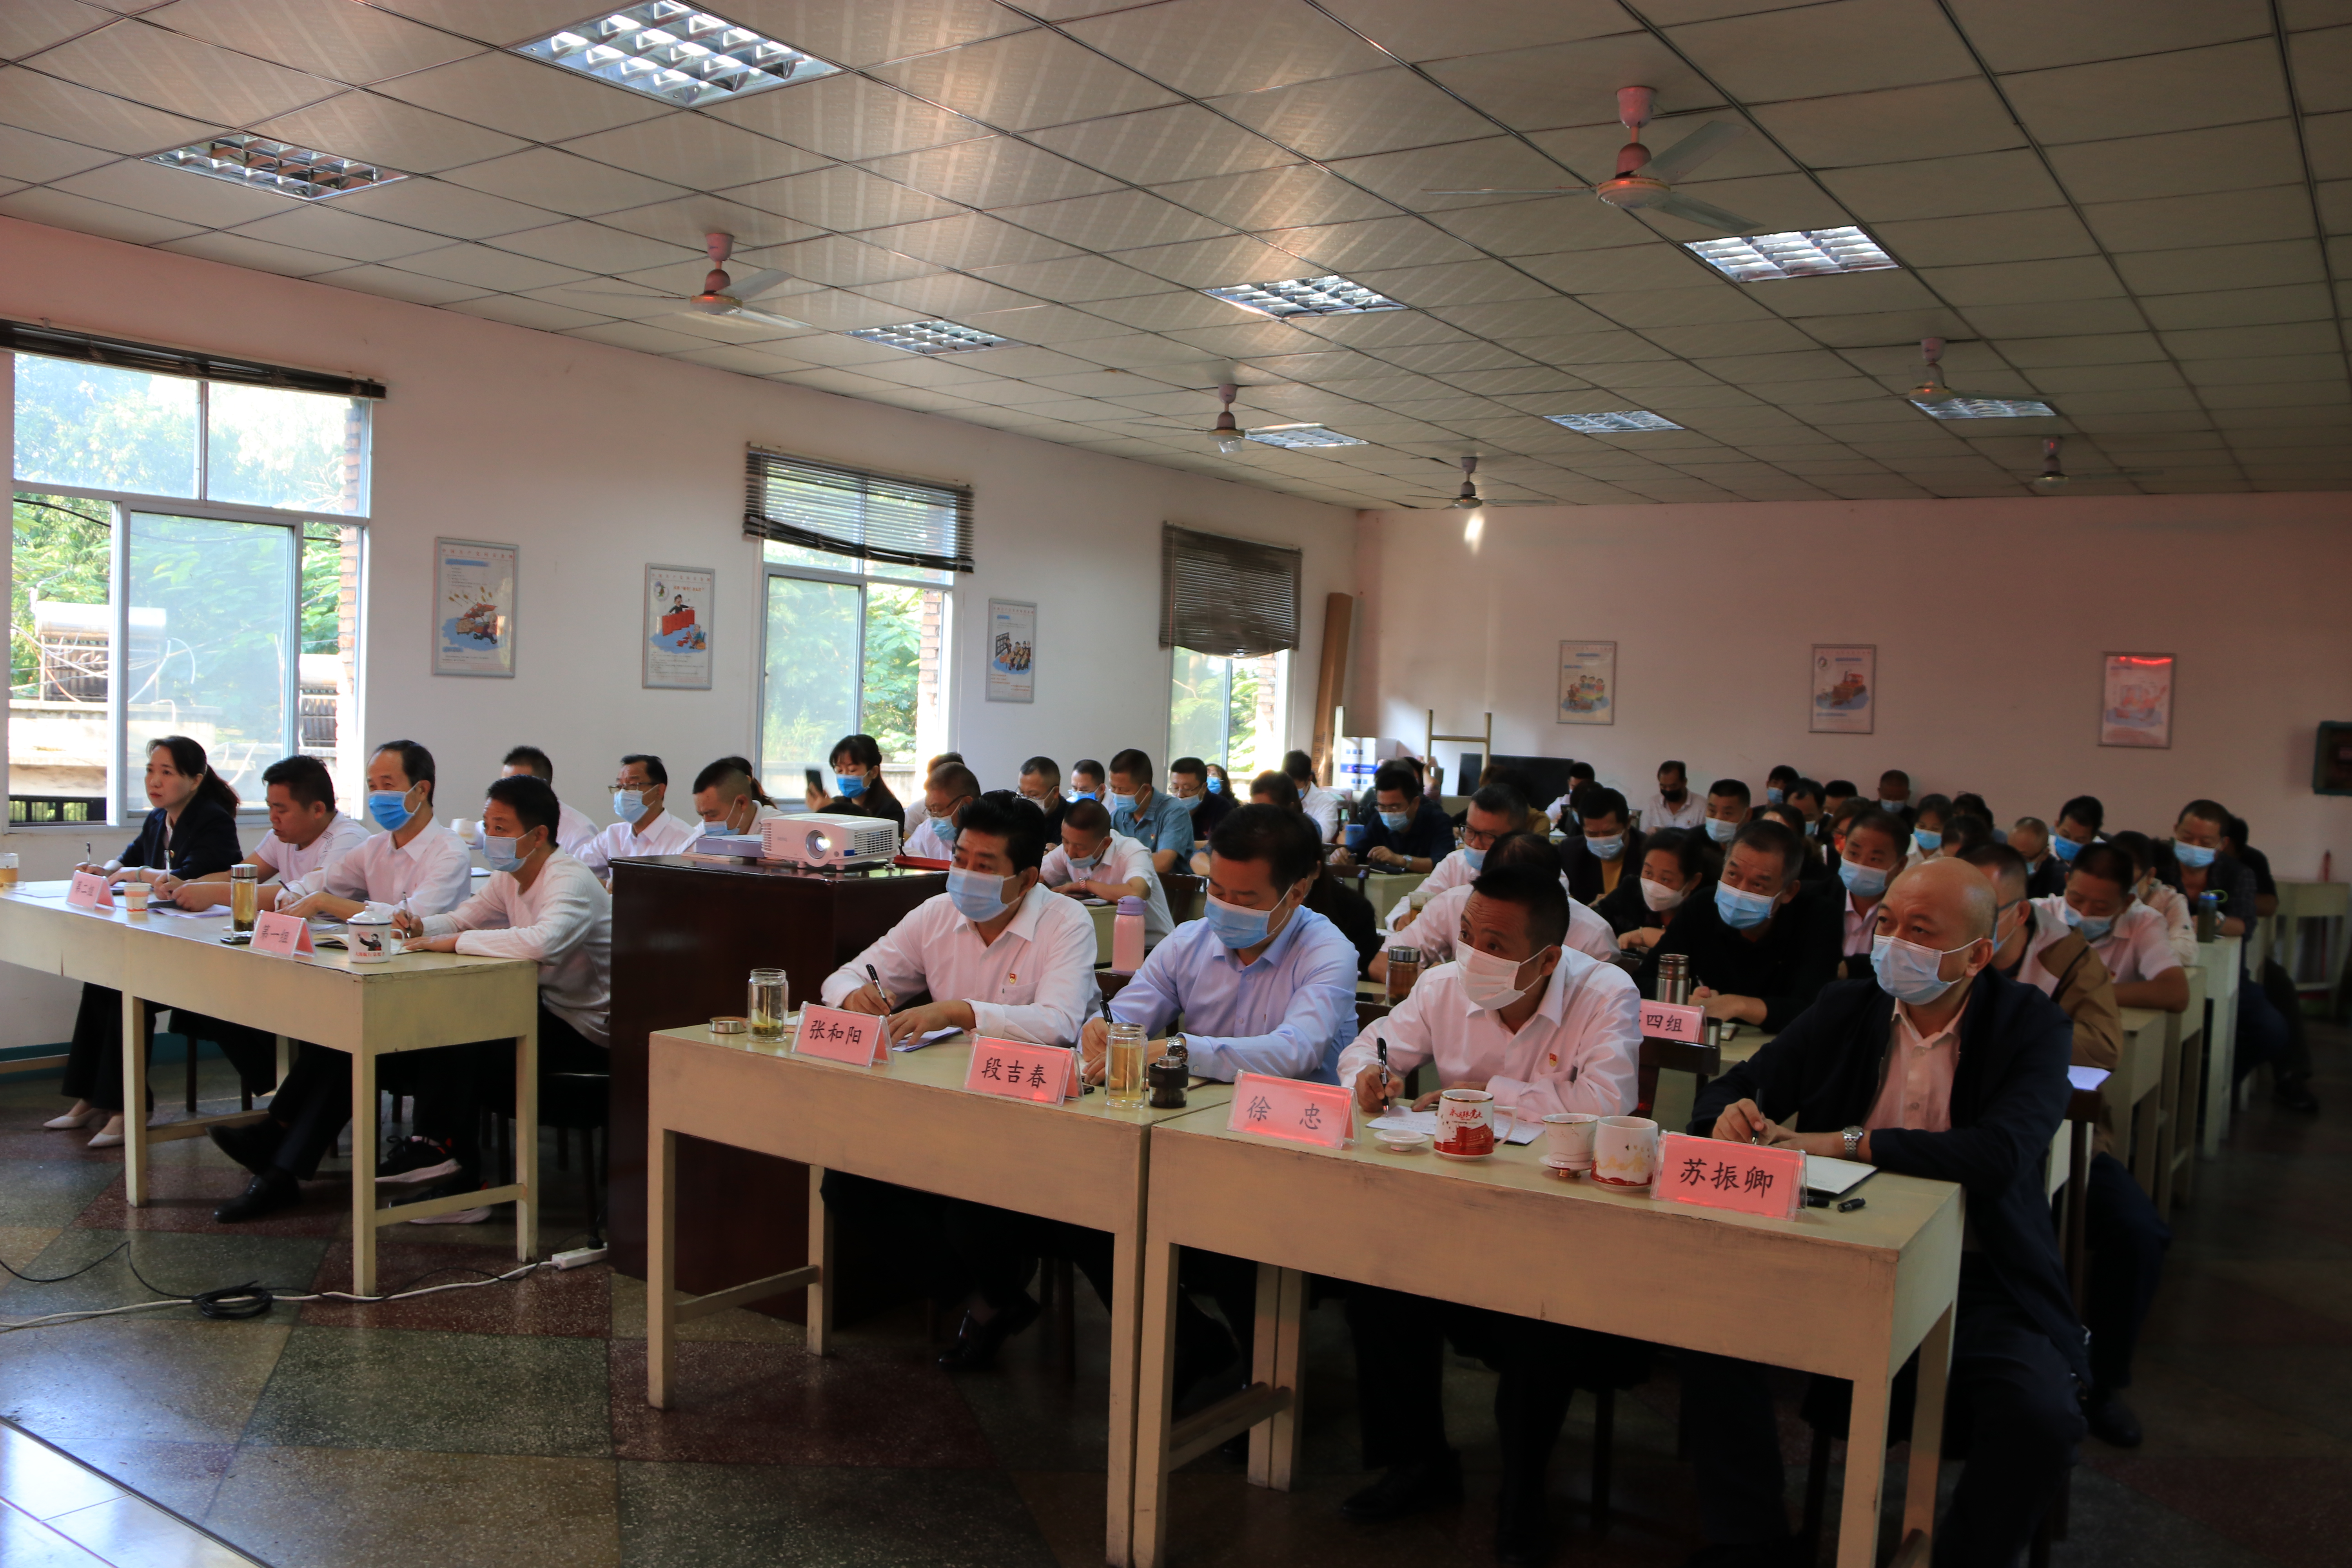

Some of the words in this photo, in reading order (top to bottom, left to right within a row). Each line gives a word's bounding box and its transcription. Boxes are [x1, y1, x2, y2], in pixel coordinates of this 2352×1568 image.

[260, 924, 289, 943] 第一组
[809, 1020, 862, 1044] 张和阳
[1640, 1010, 1682, 1032] 四组
[982, 1057, 1046, 1089] 段吉春
